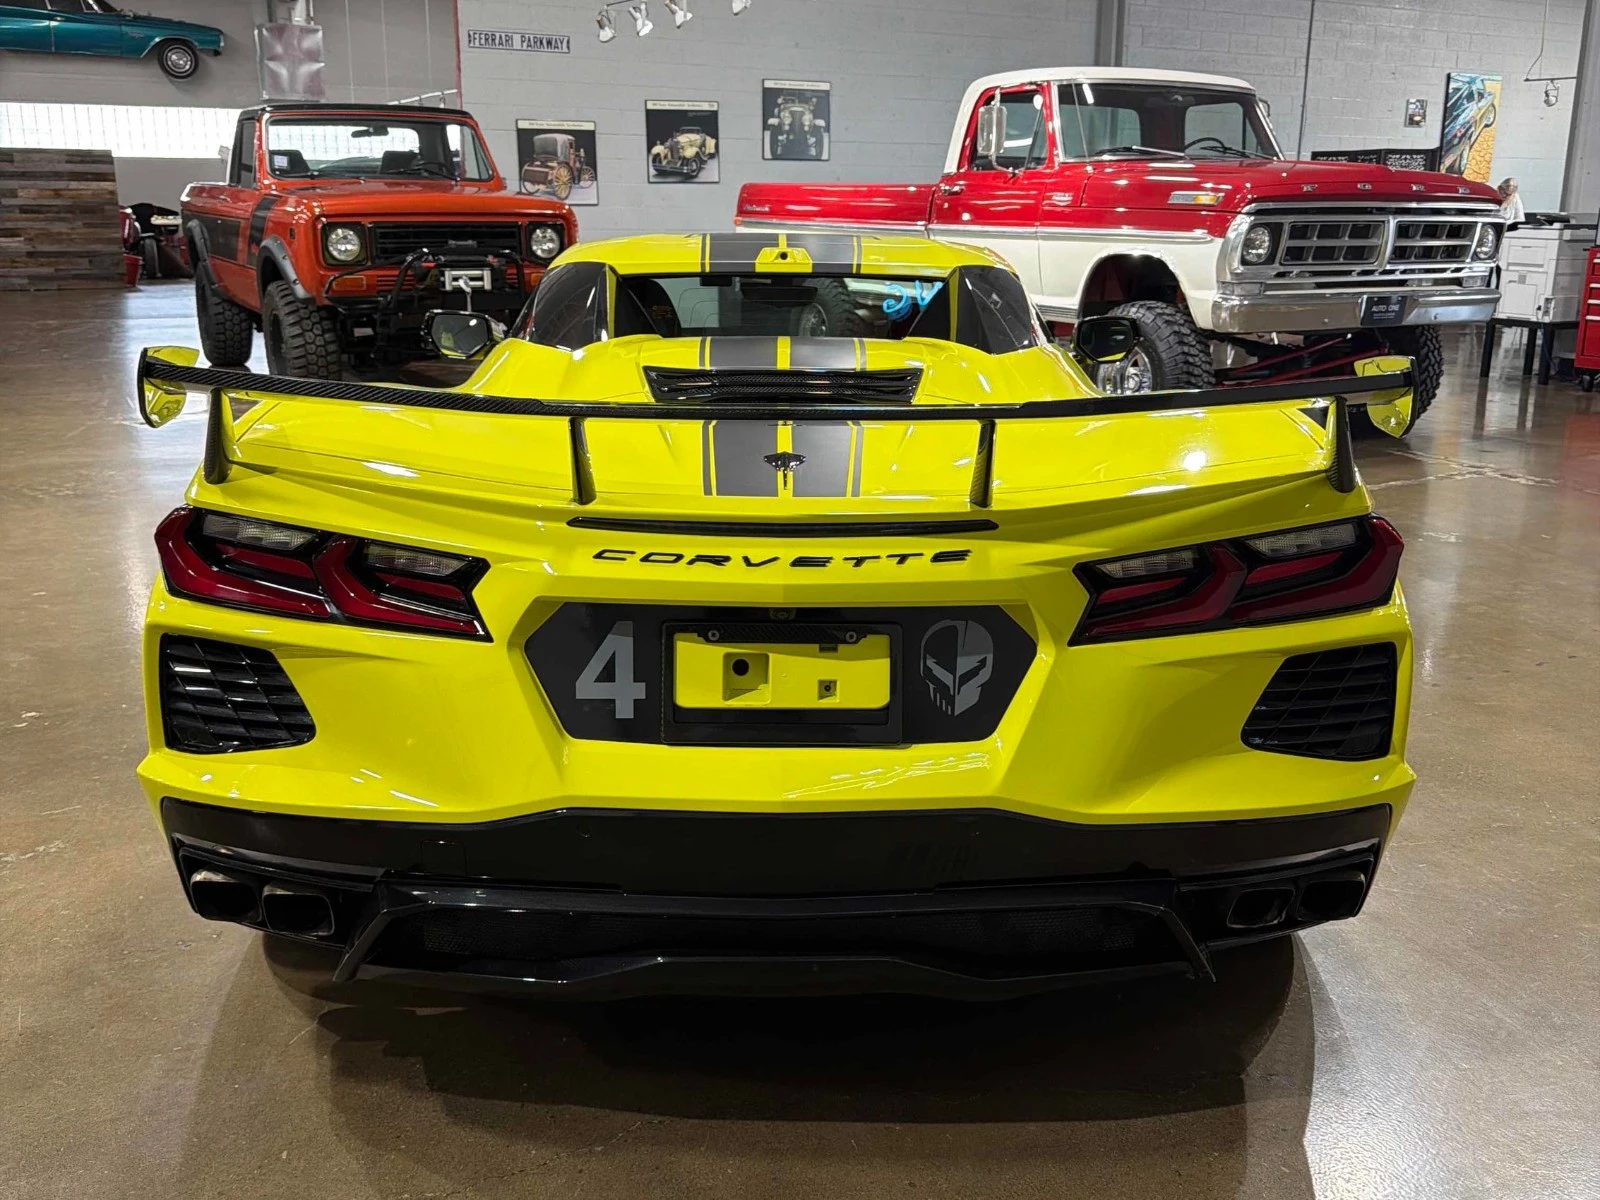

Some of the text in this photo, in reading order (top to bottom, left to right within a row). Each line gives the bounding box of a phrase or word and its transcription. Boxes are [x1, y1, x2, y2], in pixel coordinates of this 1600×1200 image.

[472, 32, 565, 51] FERRARI PARKWAY
[1301, 183, 1471, 194] FORD
[592, 549, 973, 568] CORVETTE
[575, 620, 646, 719] 4
